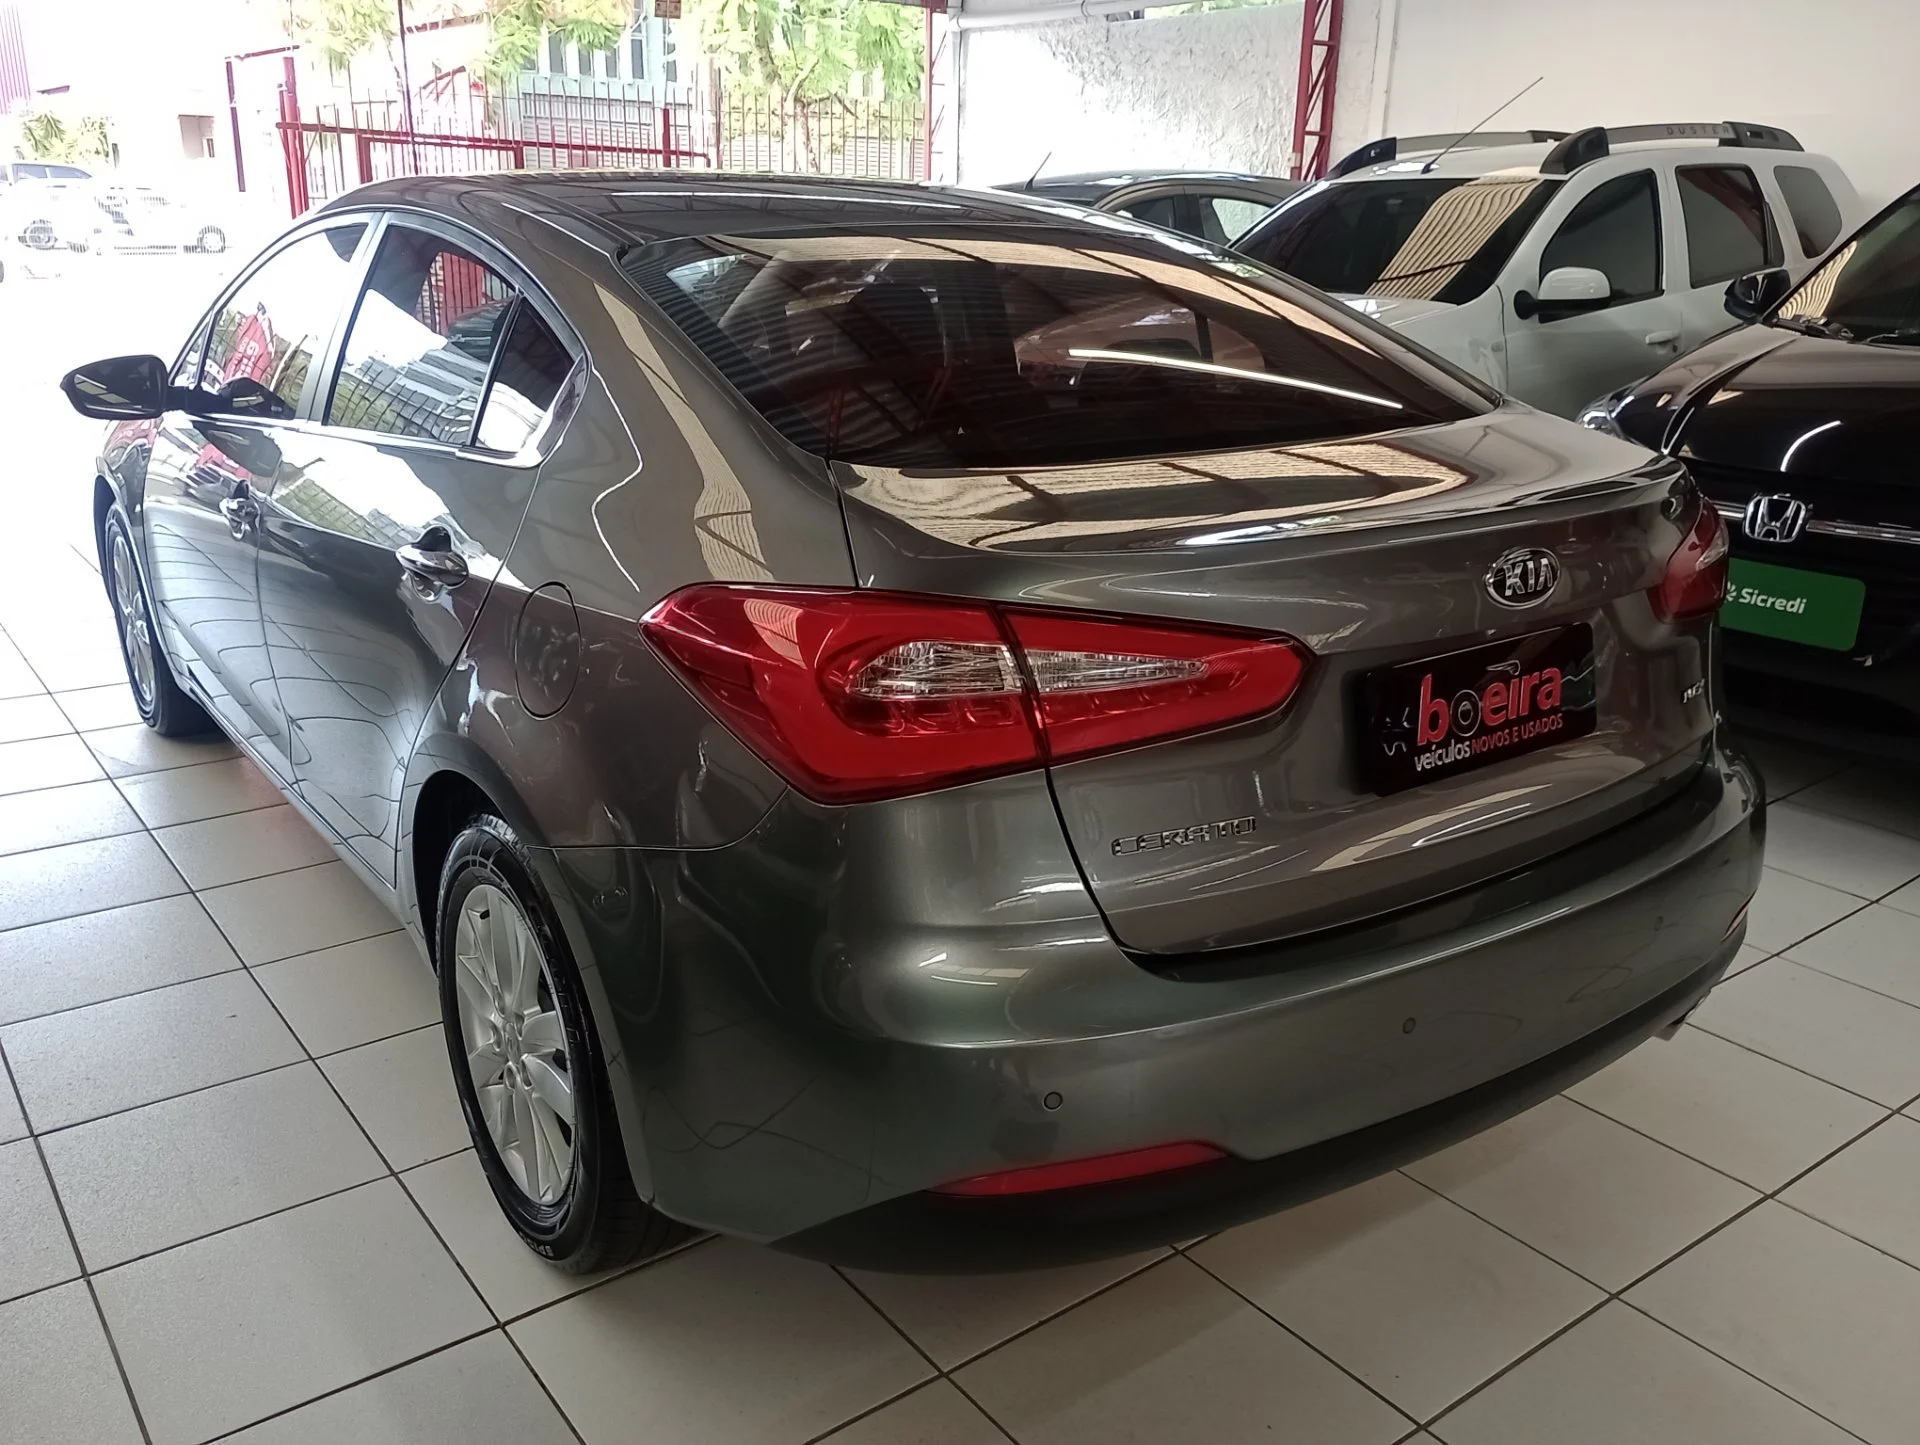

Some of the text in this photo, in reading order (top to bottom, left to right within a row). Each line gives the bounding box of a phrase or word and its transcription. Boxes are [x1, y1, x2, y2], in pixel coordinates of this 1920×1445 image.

[1666, 125, 1730, 136] DUSTER
[1503, 558, 1553, 597] KIA
[1739, 587, 1807, 614] Sicredi
[1416, 667, 1562, 746] boeira
[1414, 713, 1563, 771] veículos NOVOS E USADOS
[1111, 816, 1256, 856] CERATO
